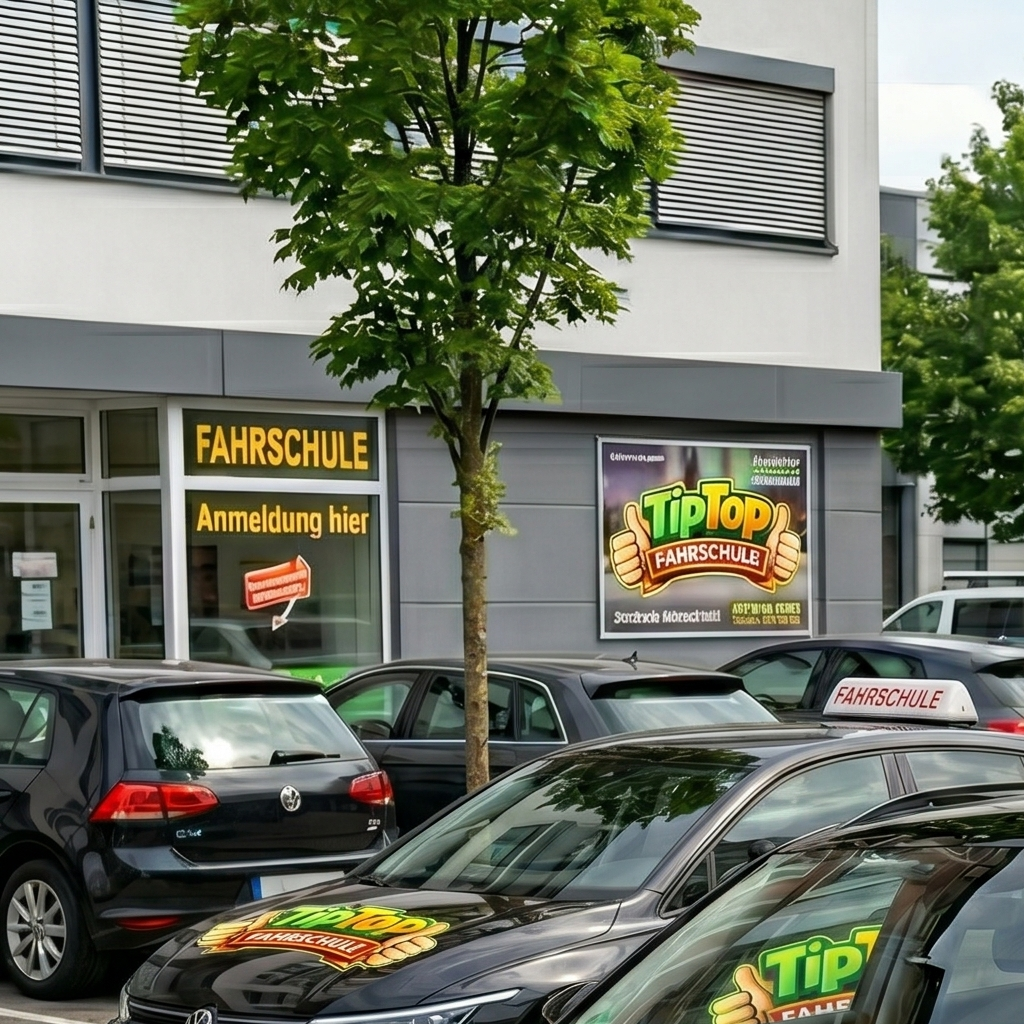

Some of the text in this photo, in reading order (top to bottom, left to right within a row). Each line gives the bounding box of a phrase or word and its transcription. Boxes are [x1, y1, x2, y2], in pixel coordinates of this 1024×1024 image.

[196, 424, 369, 470] FAHRSCHULE
[196, 503, 369, 539] Anmeldung hier
[643, 482, 772, 540] TipTop
[654, 543, 760, 569] FAHRSCHULE
[833, 686, 944, 709] FAHRSCHULE
[271, 907, 428, 935] TipTop
